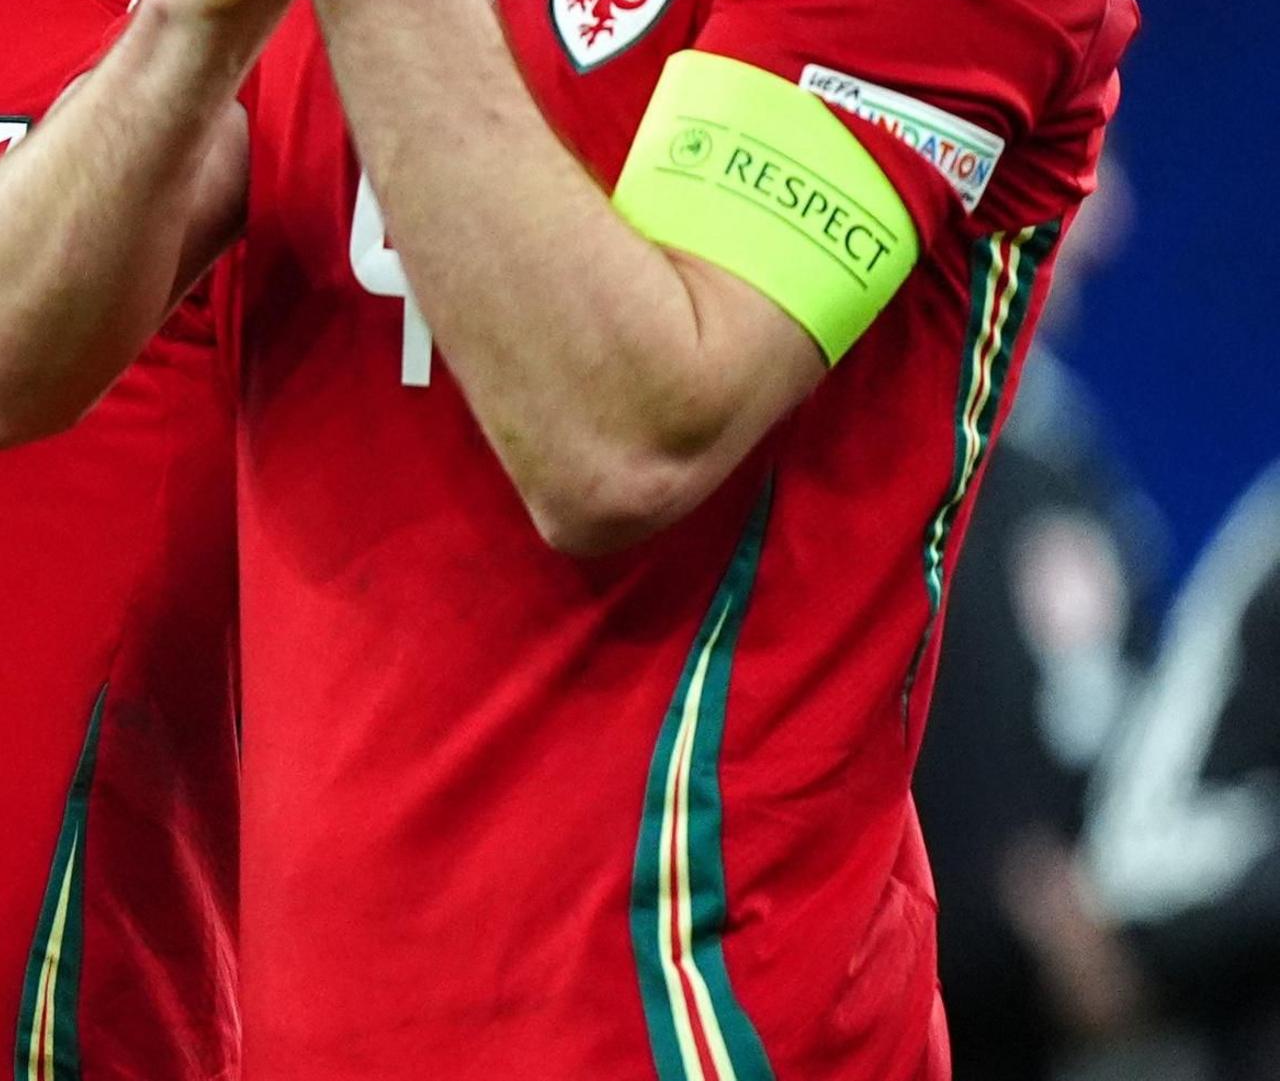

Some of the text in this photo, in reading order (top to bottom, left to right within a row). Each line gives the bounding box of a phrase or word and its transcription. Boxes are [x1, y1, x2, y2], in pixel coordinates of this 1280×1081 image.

[808, 70, 861, 101] UEFA
[839, 104, 991, 186] NDATION
[724, 146, 891, 272] RESPECT
